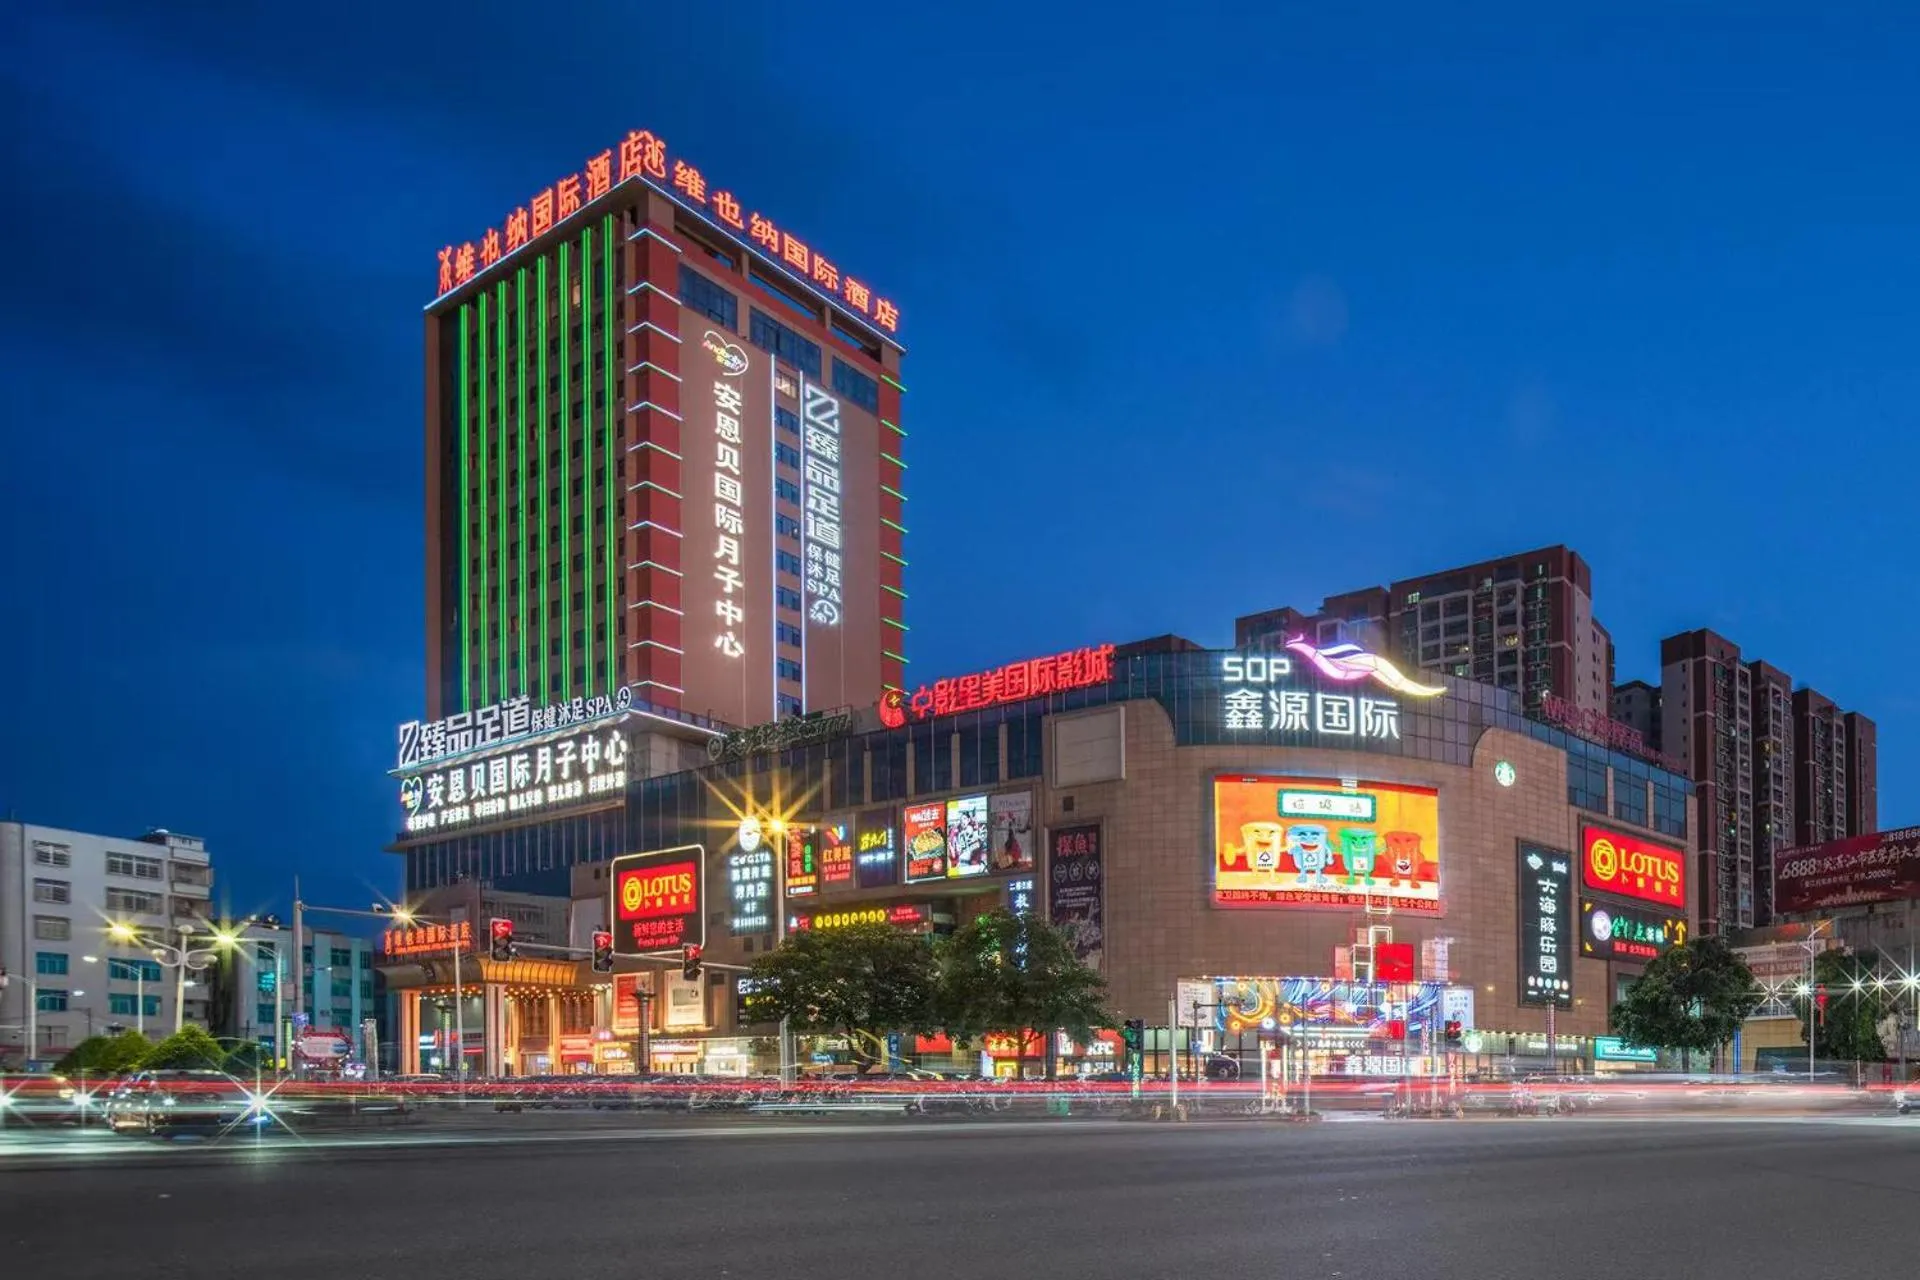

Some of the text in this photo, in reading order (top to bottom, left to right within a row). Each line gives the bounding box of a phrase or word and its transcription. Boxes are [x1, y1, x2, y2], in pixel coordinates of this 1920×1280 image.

[456, 130, 652, 284] 维也纳国际酒店
[674, 161, 899, 333] 维也纳国际酒店
[805, 424, 840, 549] 臻品足道
[712, 381, 743, 658] 安恩贝国际月子中心
[806, 578, 841, 604] SPA
[1223, 657, 1290, 683] SOP
[420, 694, 530, 761] 臻品足道
[1224, 689, 1400, 740] 鑫源国际
[427, 730, 628, 809] 安恩贝国际月子中心
[643, 873, 692, 897] LOTUS
[1620, 848, 1680, 883] LOTUS
[1087, 1041, 1114, 1056] KFC
[1345, 1054, 1413, 1076] 鑫源国
